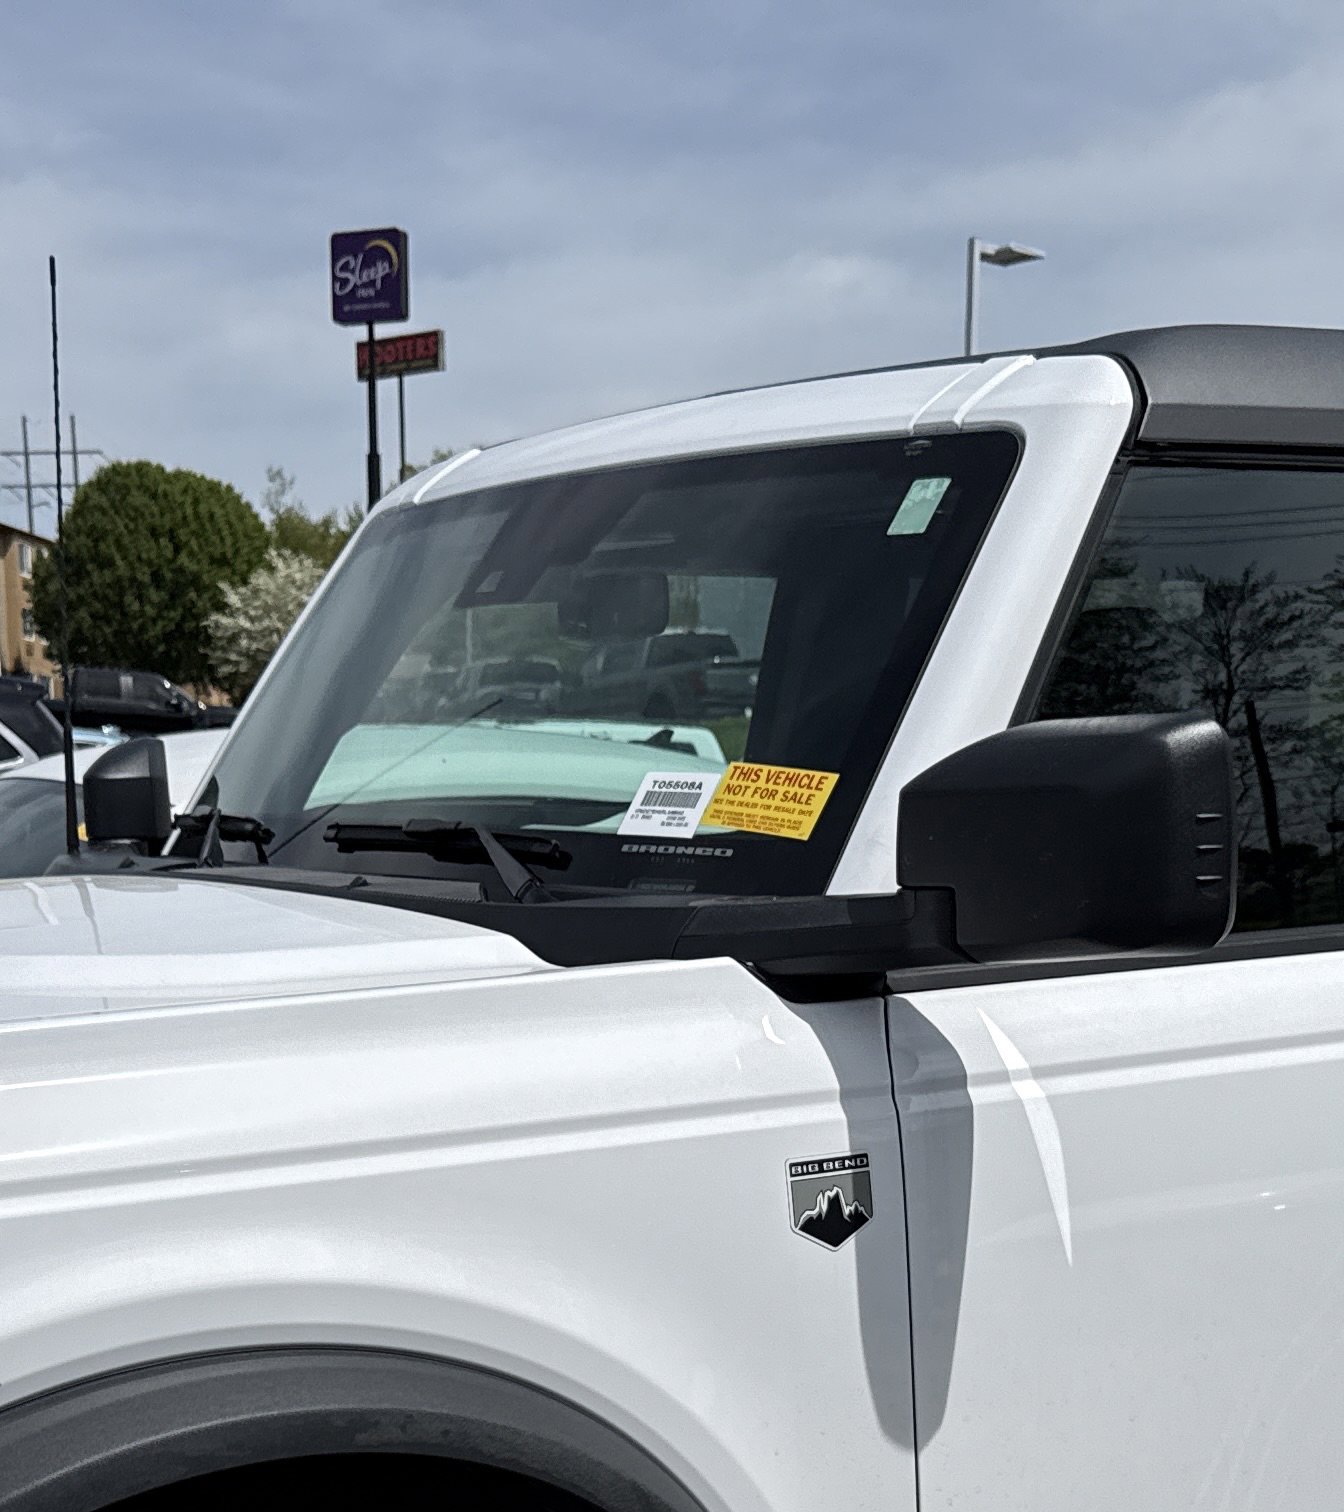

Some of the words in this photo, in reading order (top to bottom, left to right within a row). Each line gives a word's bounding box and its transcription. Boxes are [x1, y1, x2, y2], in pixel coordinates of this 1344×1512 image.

[334, 253, 391, 296] Sleep
[729, 766, 763, 783] THIS
[764, 769, 829, 792] VEHICLE
[723, 783, 751, 798] NOT
[751, 786, 778, 801] FOR
[780, 790, 816, 806] SALE
[621, 844, 734, 857] BRONCO
[791, 1163, 819, 1175] BIG
[823, 1157, 867, 1170] BEND
